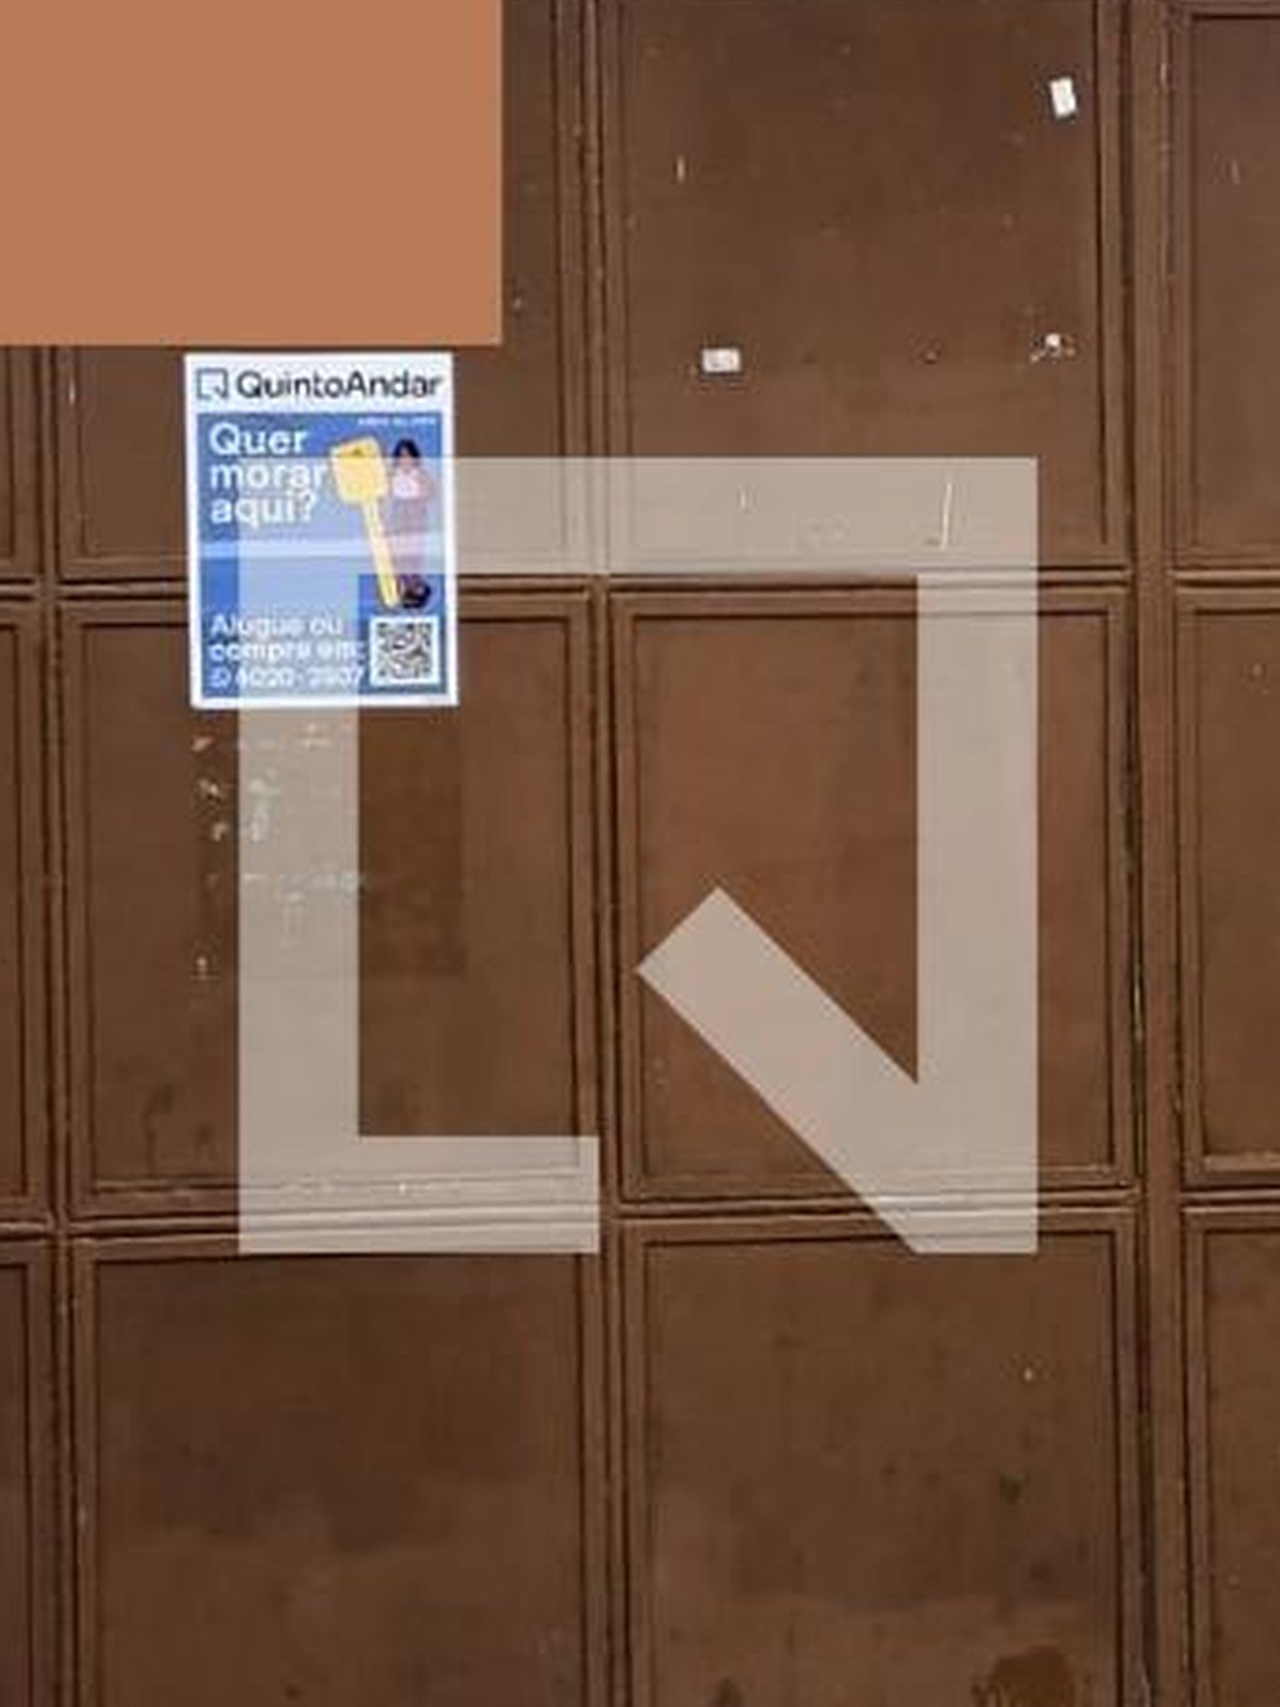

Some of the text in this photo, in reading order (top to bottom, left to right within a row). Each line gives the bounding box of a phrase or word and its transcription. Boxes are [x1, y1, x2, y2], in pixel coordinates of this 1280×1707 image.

[235, 369, 443, 399] QuintoAndar
[208, 422, 308, 456] Quer
[209, 462, 328, 489] morar
[209, 490, 317, 528] aqui?
[210, 613, 342, 641] Alugue ou
